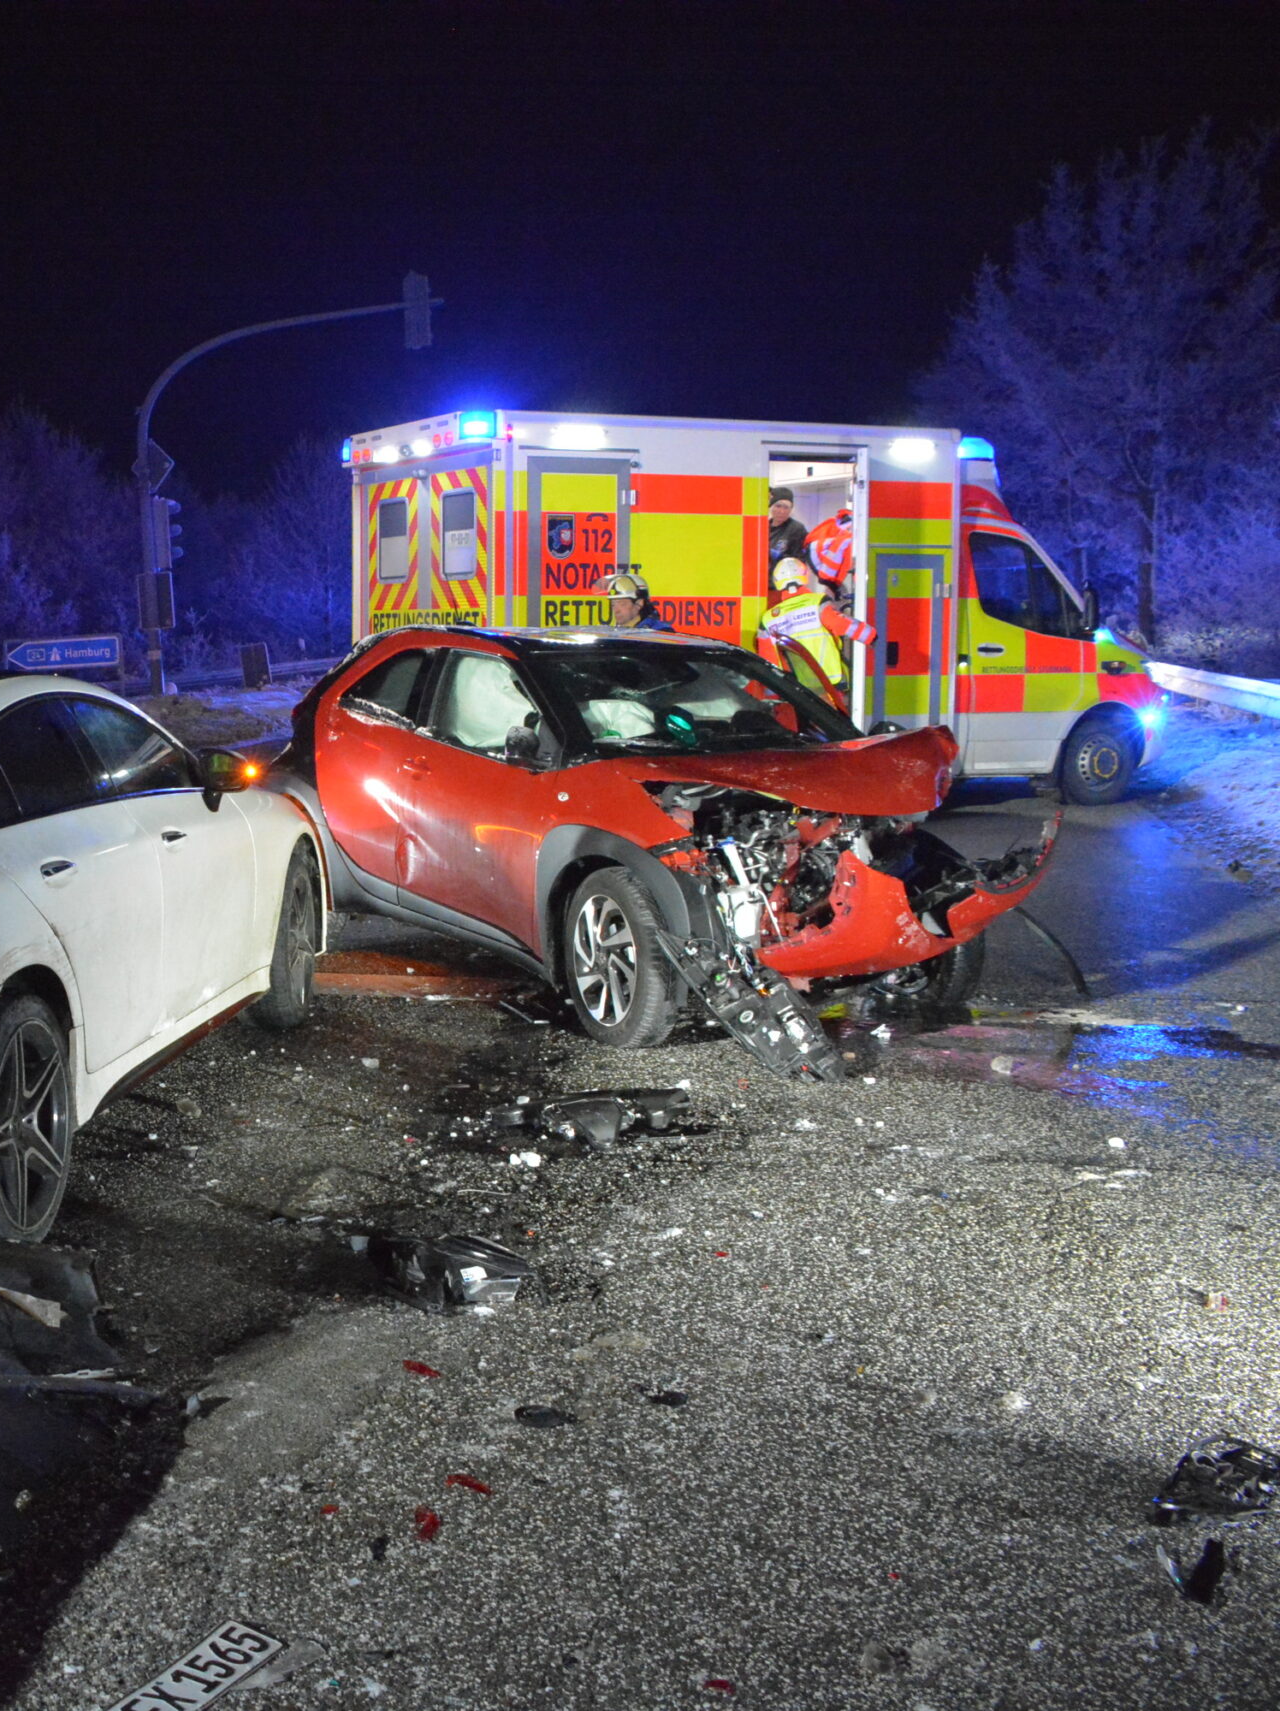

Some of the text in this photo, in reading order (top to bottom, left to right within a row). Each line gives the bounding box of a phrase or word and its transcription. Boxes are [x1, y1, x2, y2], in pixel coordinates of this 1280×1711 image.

[581, 529, 613, 553] 112
[545, 600, 737, 627] RETTUDIENST
[64, 648, 111, 659] Hamburg
[170, 1625, 270, 1694] 1565
